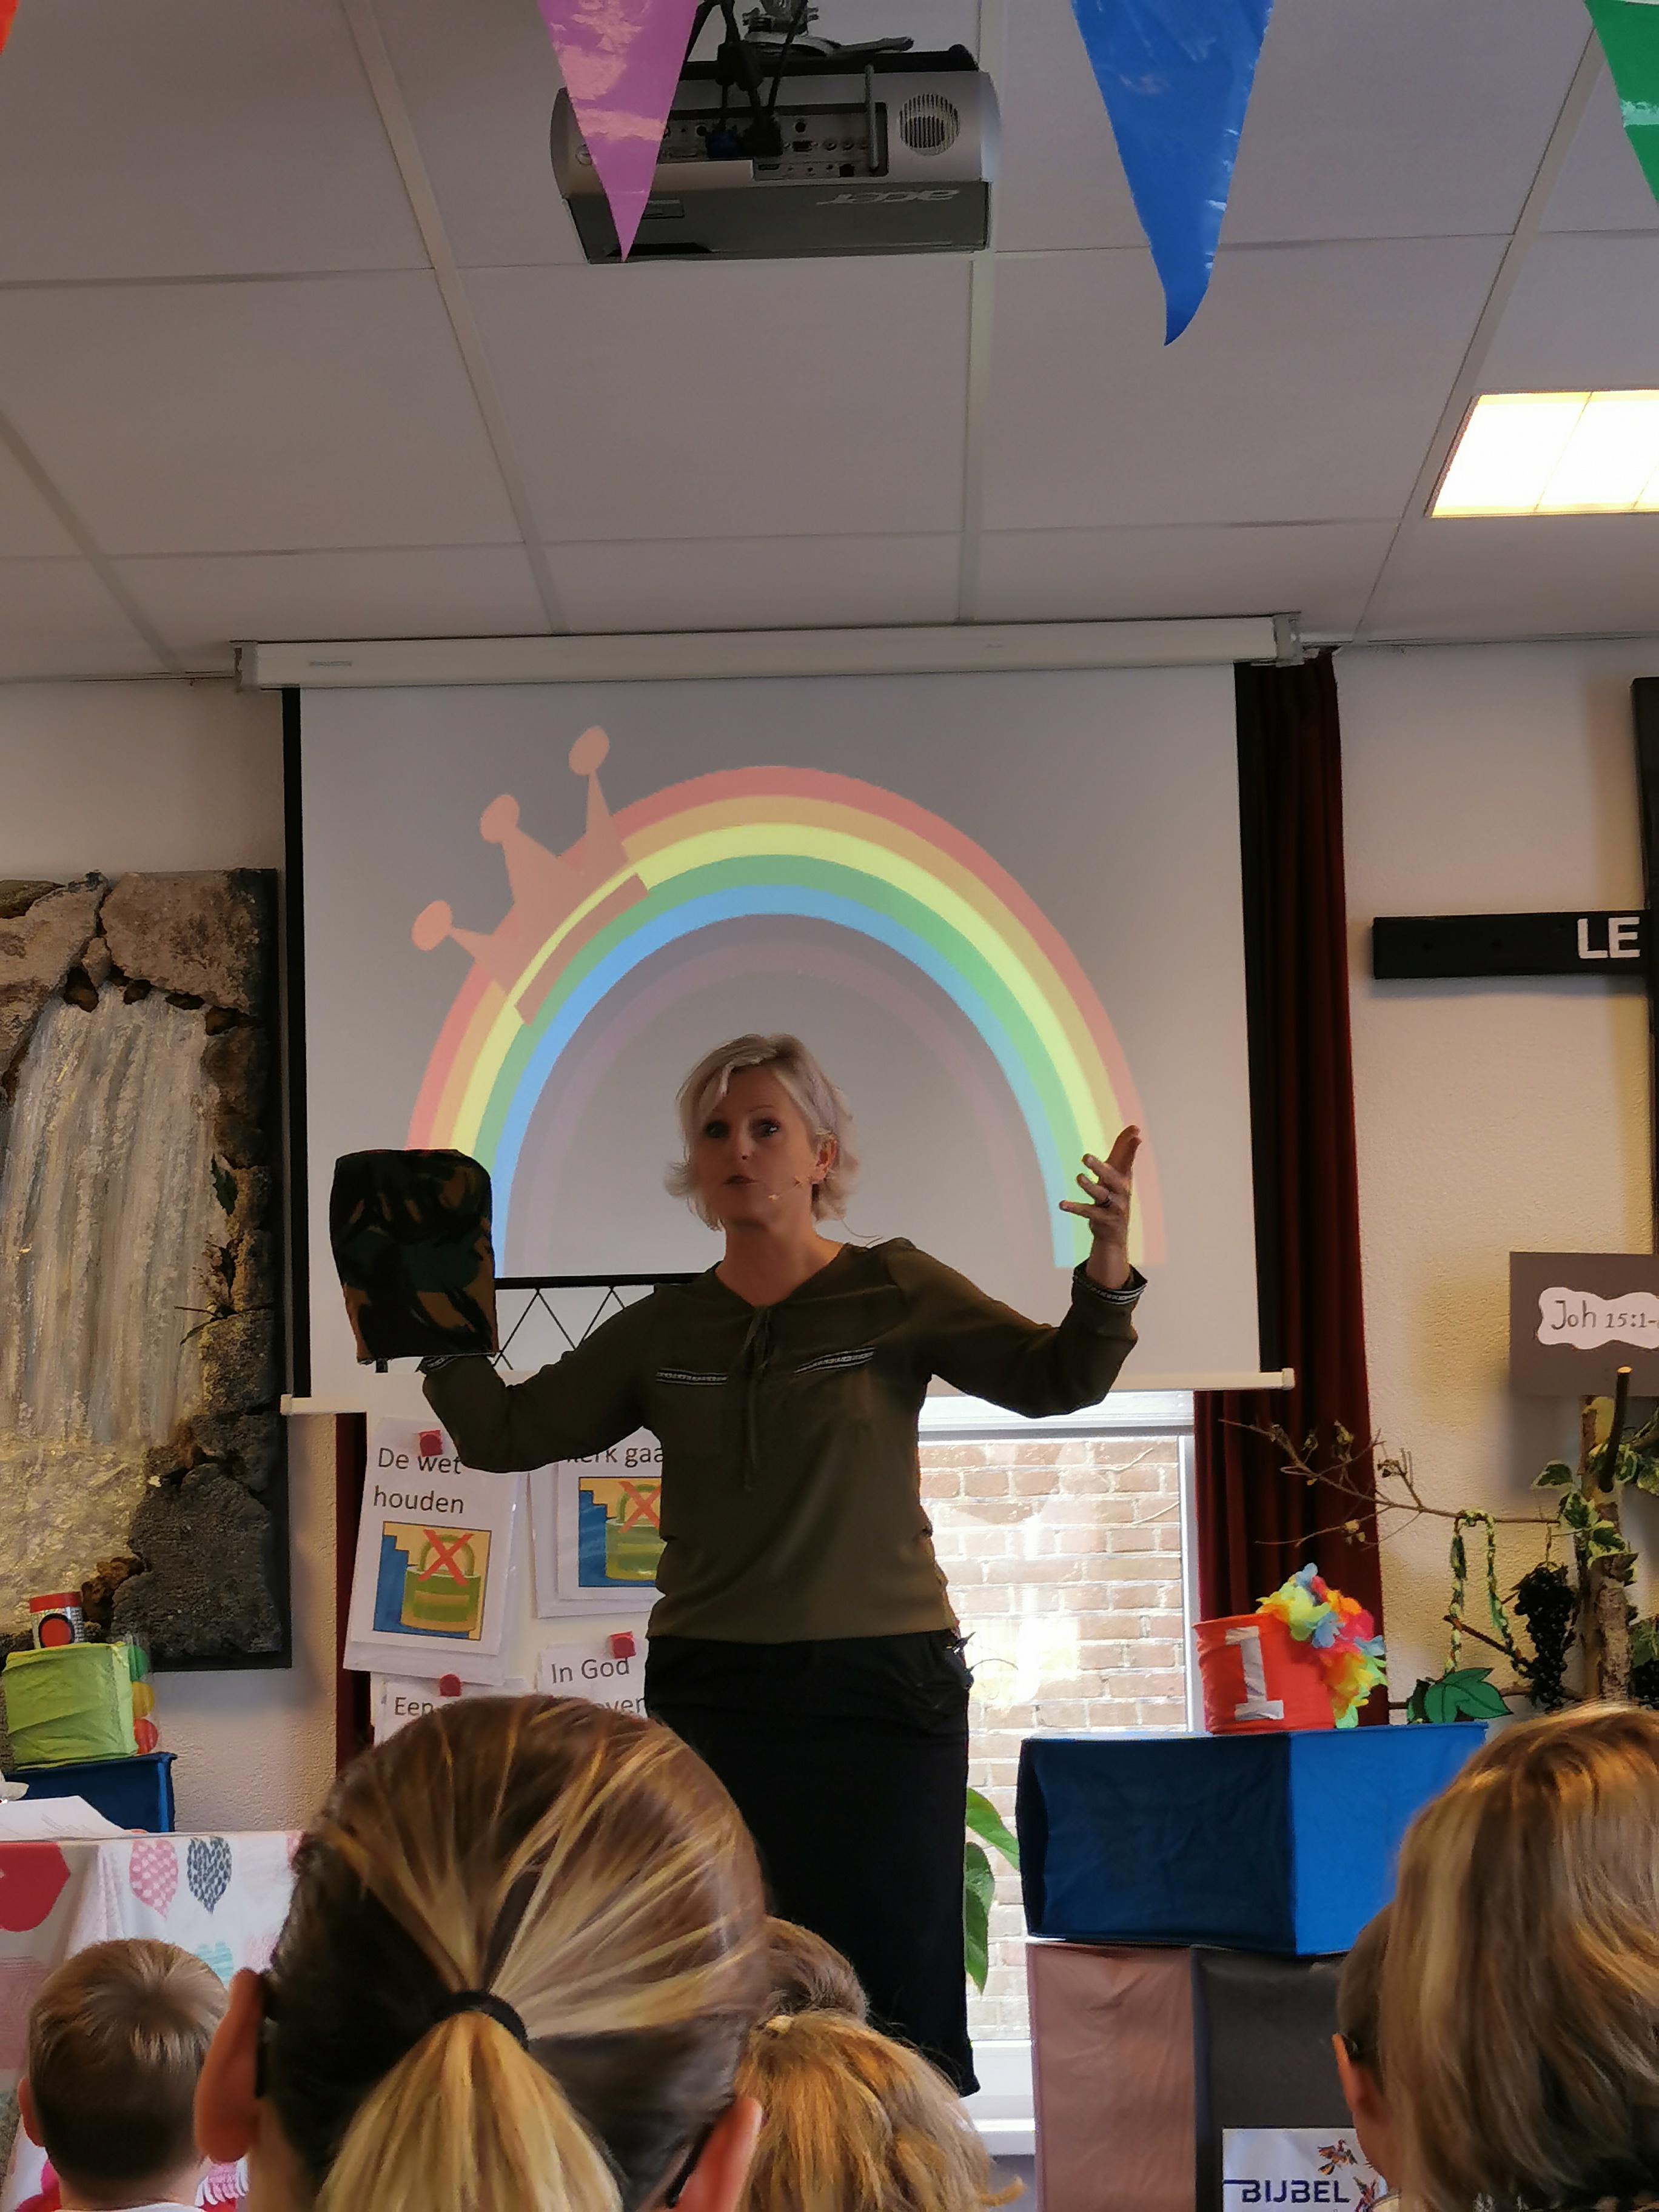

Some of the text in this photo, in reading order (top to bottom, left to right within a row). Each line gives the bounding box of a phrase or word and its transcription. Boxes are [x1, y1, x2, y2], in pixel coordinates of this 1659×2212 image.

[1577, 917, 1640, 959] LE
[1551, 1300, 1659, 1330] Joh 15:1-
[378, 1447, 461, 1475] De wet
[374, 1485, 464, 1513] houden
[551, 1657, 629, 1683] In God
[1225, 1624, 1284, 1721] 1
[395, 1697, 434, 1717] Een
[1223, 2179, 1350, 2203] BIJBEL
